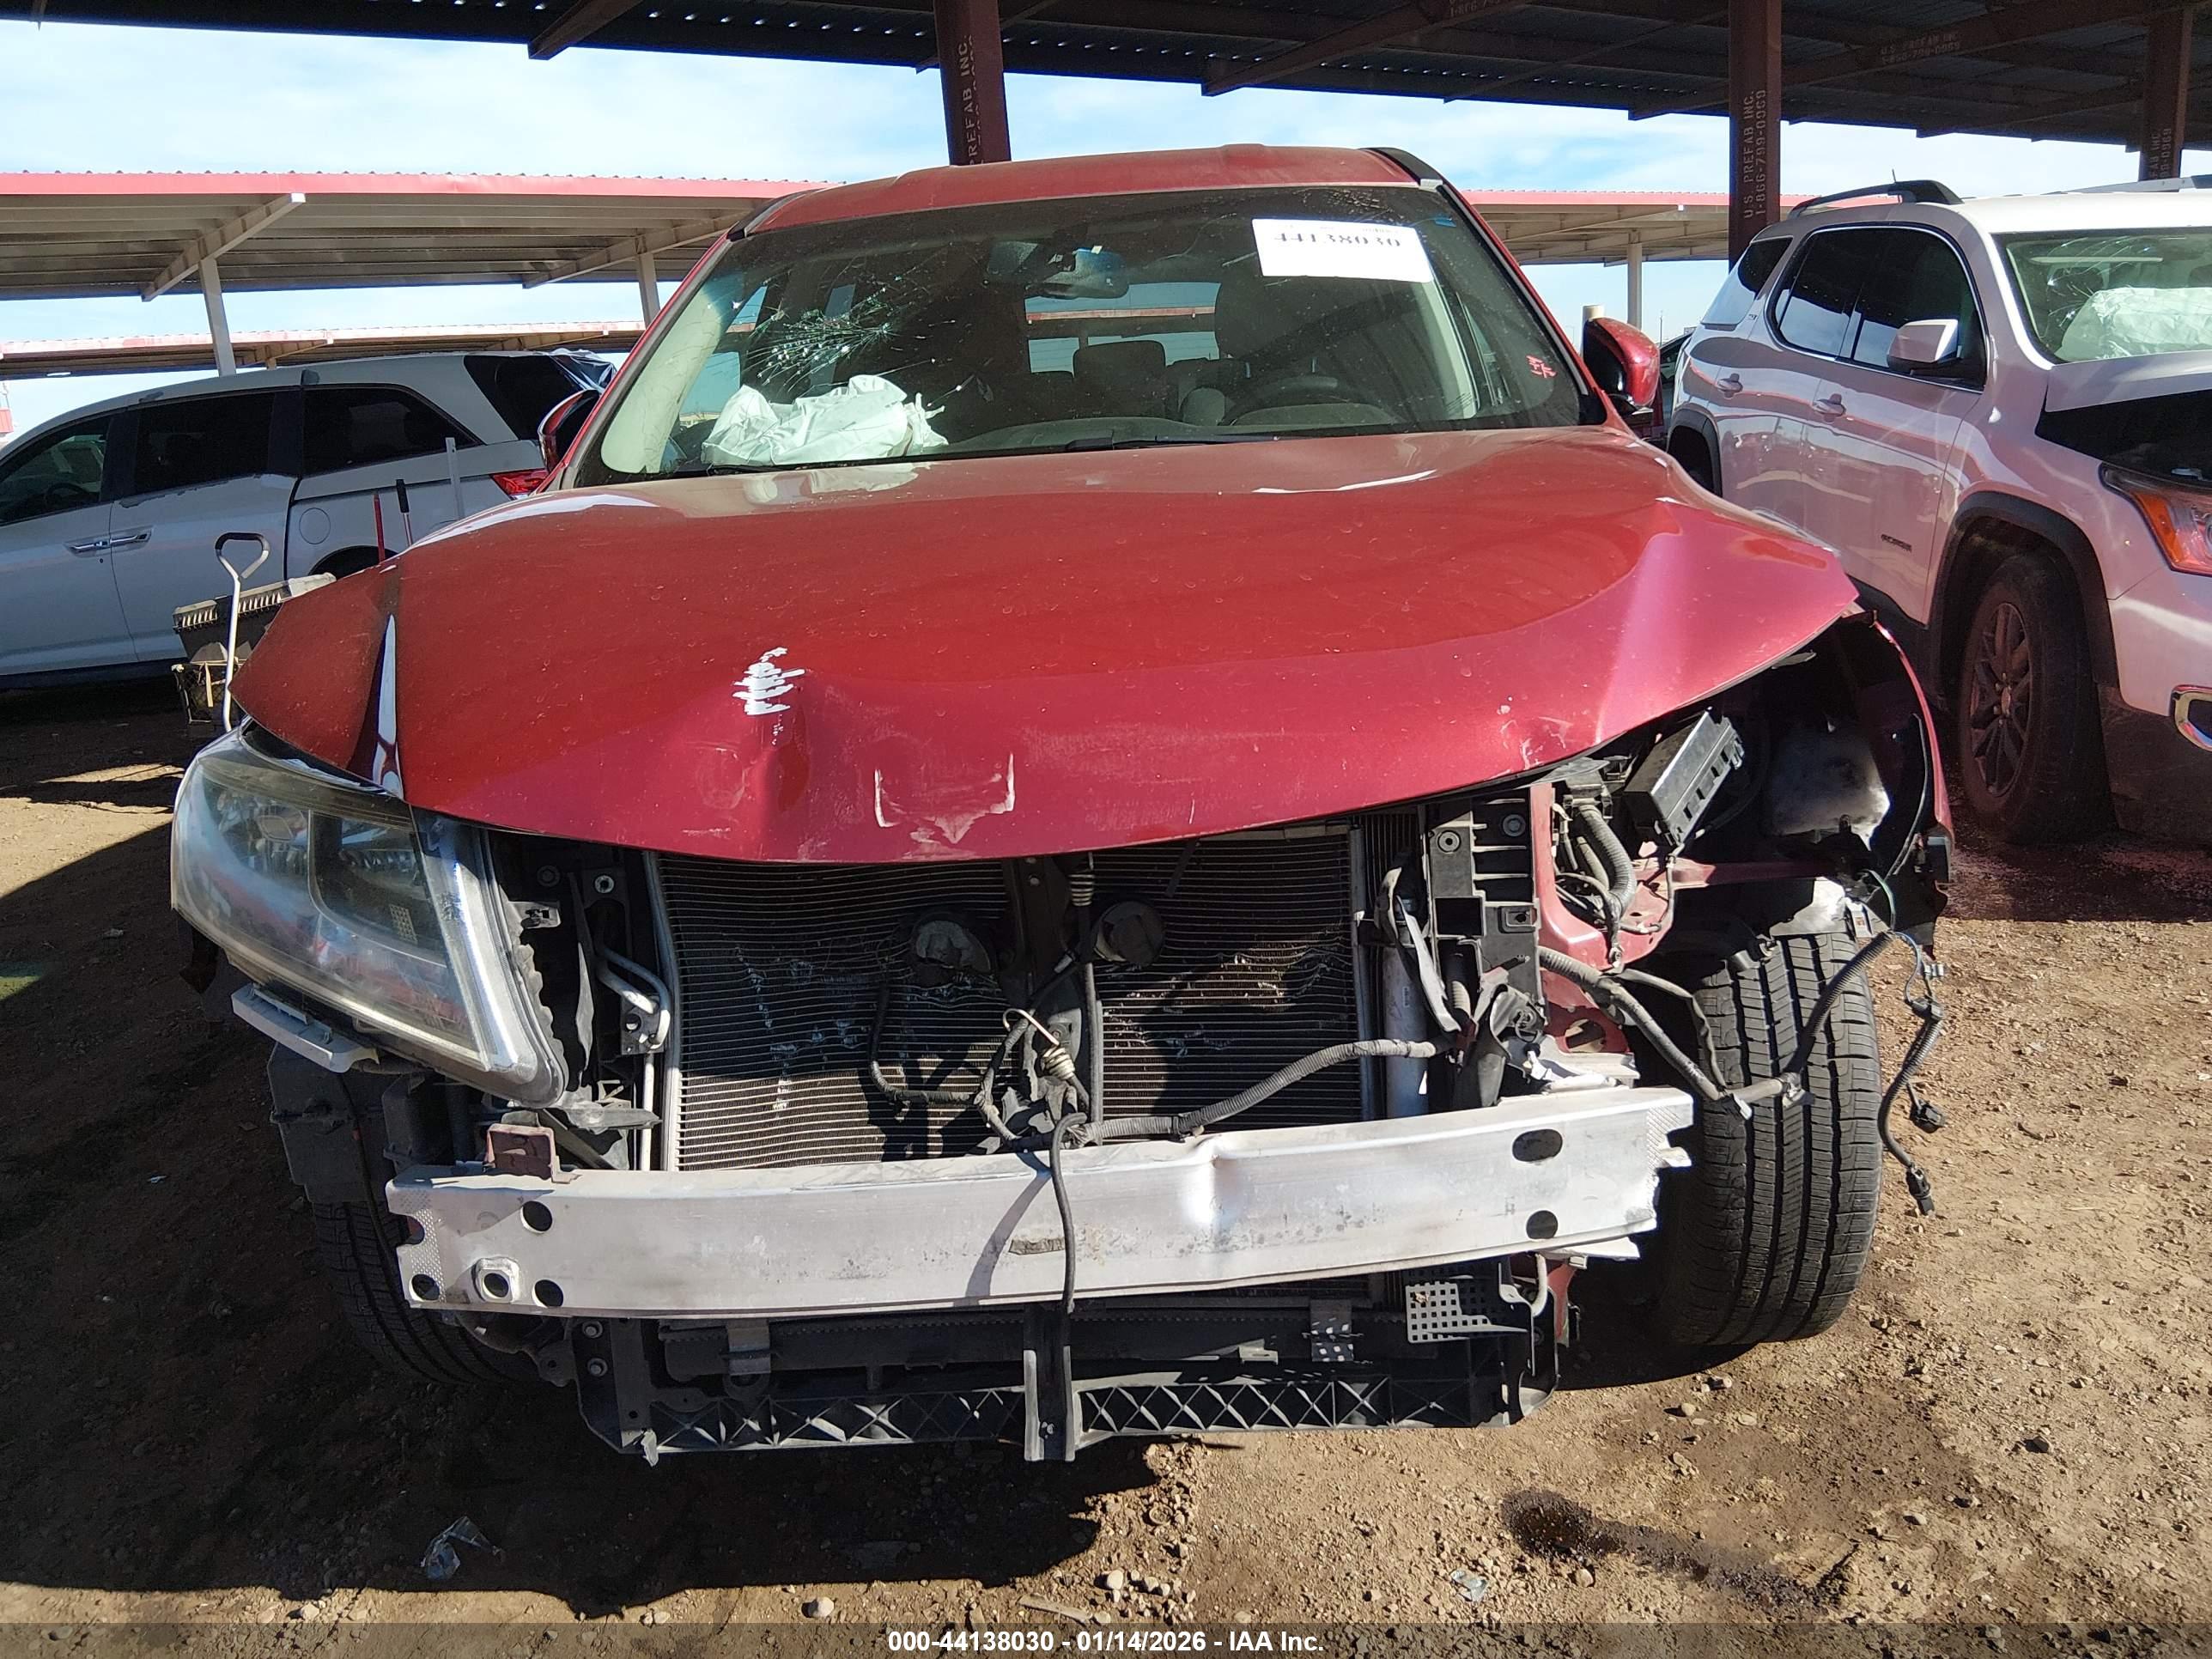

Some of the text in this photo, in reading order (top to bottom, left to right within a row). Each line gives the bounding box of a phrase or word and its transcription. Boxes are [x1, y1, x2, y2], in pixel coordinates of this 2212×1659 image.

[957, 35, 970, 76] INC.
[1743, 126, 1754, 183] PREFAB
[1273, 232, 1401, 248] 44138030
